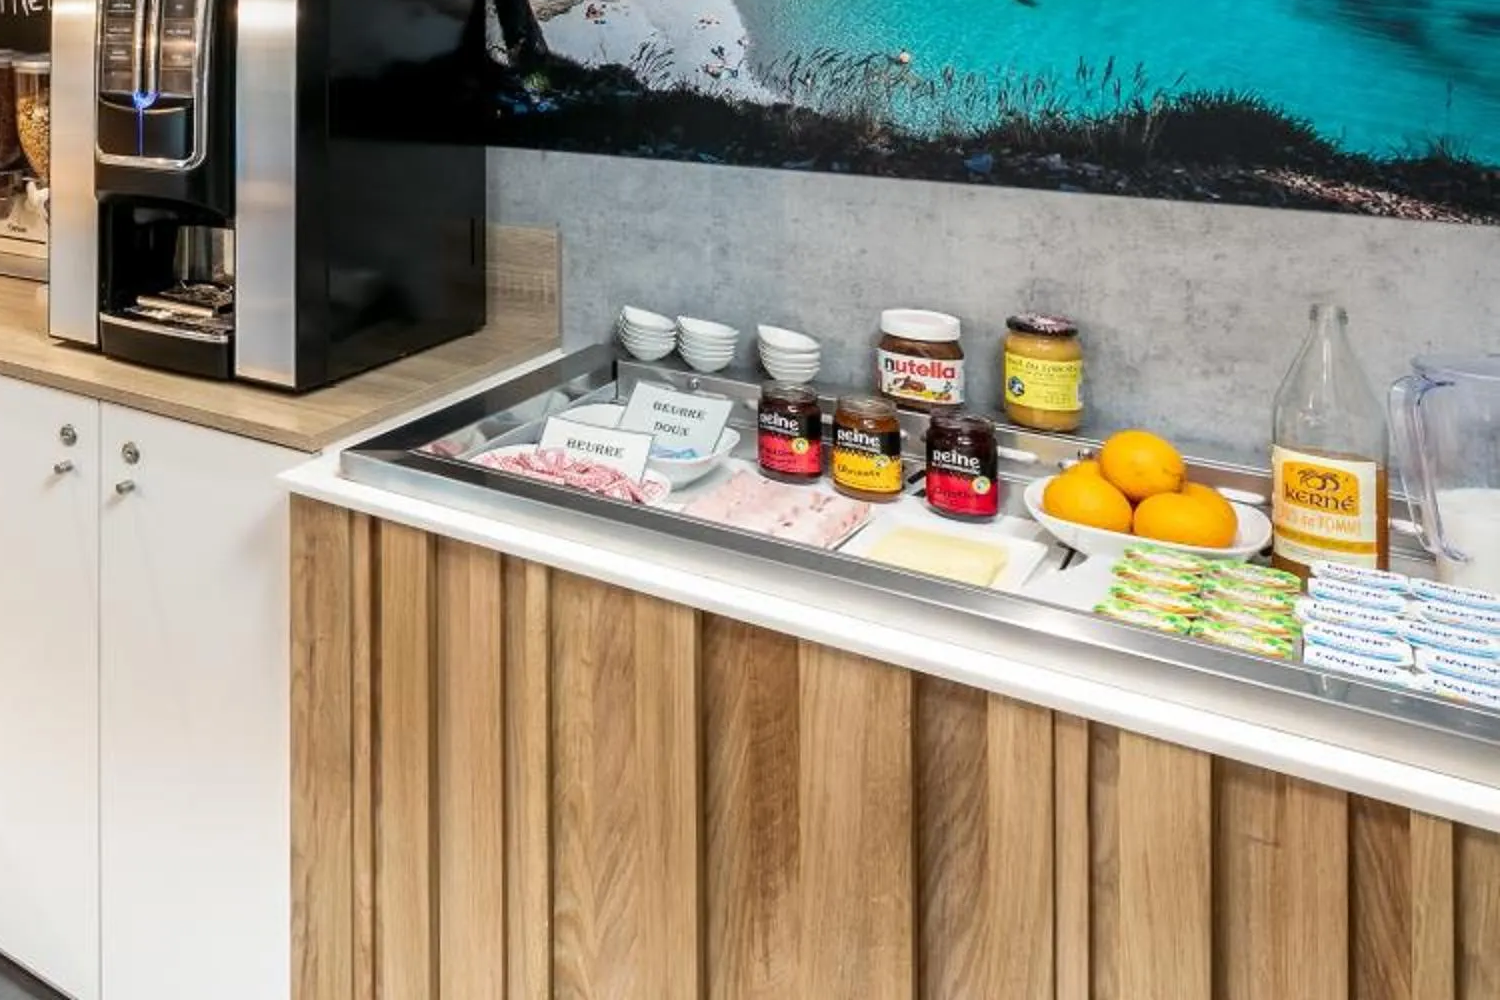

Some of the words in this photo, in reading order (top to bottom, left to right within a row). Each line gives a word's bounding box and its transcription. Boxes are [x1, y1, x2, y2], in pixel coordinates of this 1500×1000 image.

[884, 356, 956, 380] nutella
[652, 400, 706, 421] BEURRE
[565, 437, 624, 459] BEURRE
